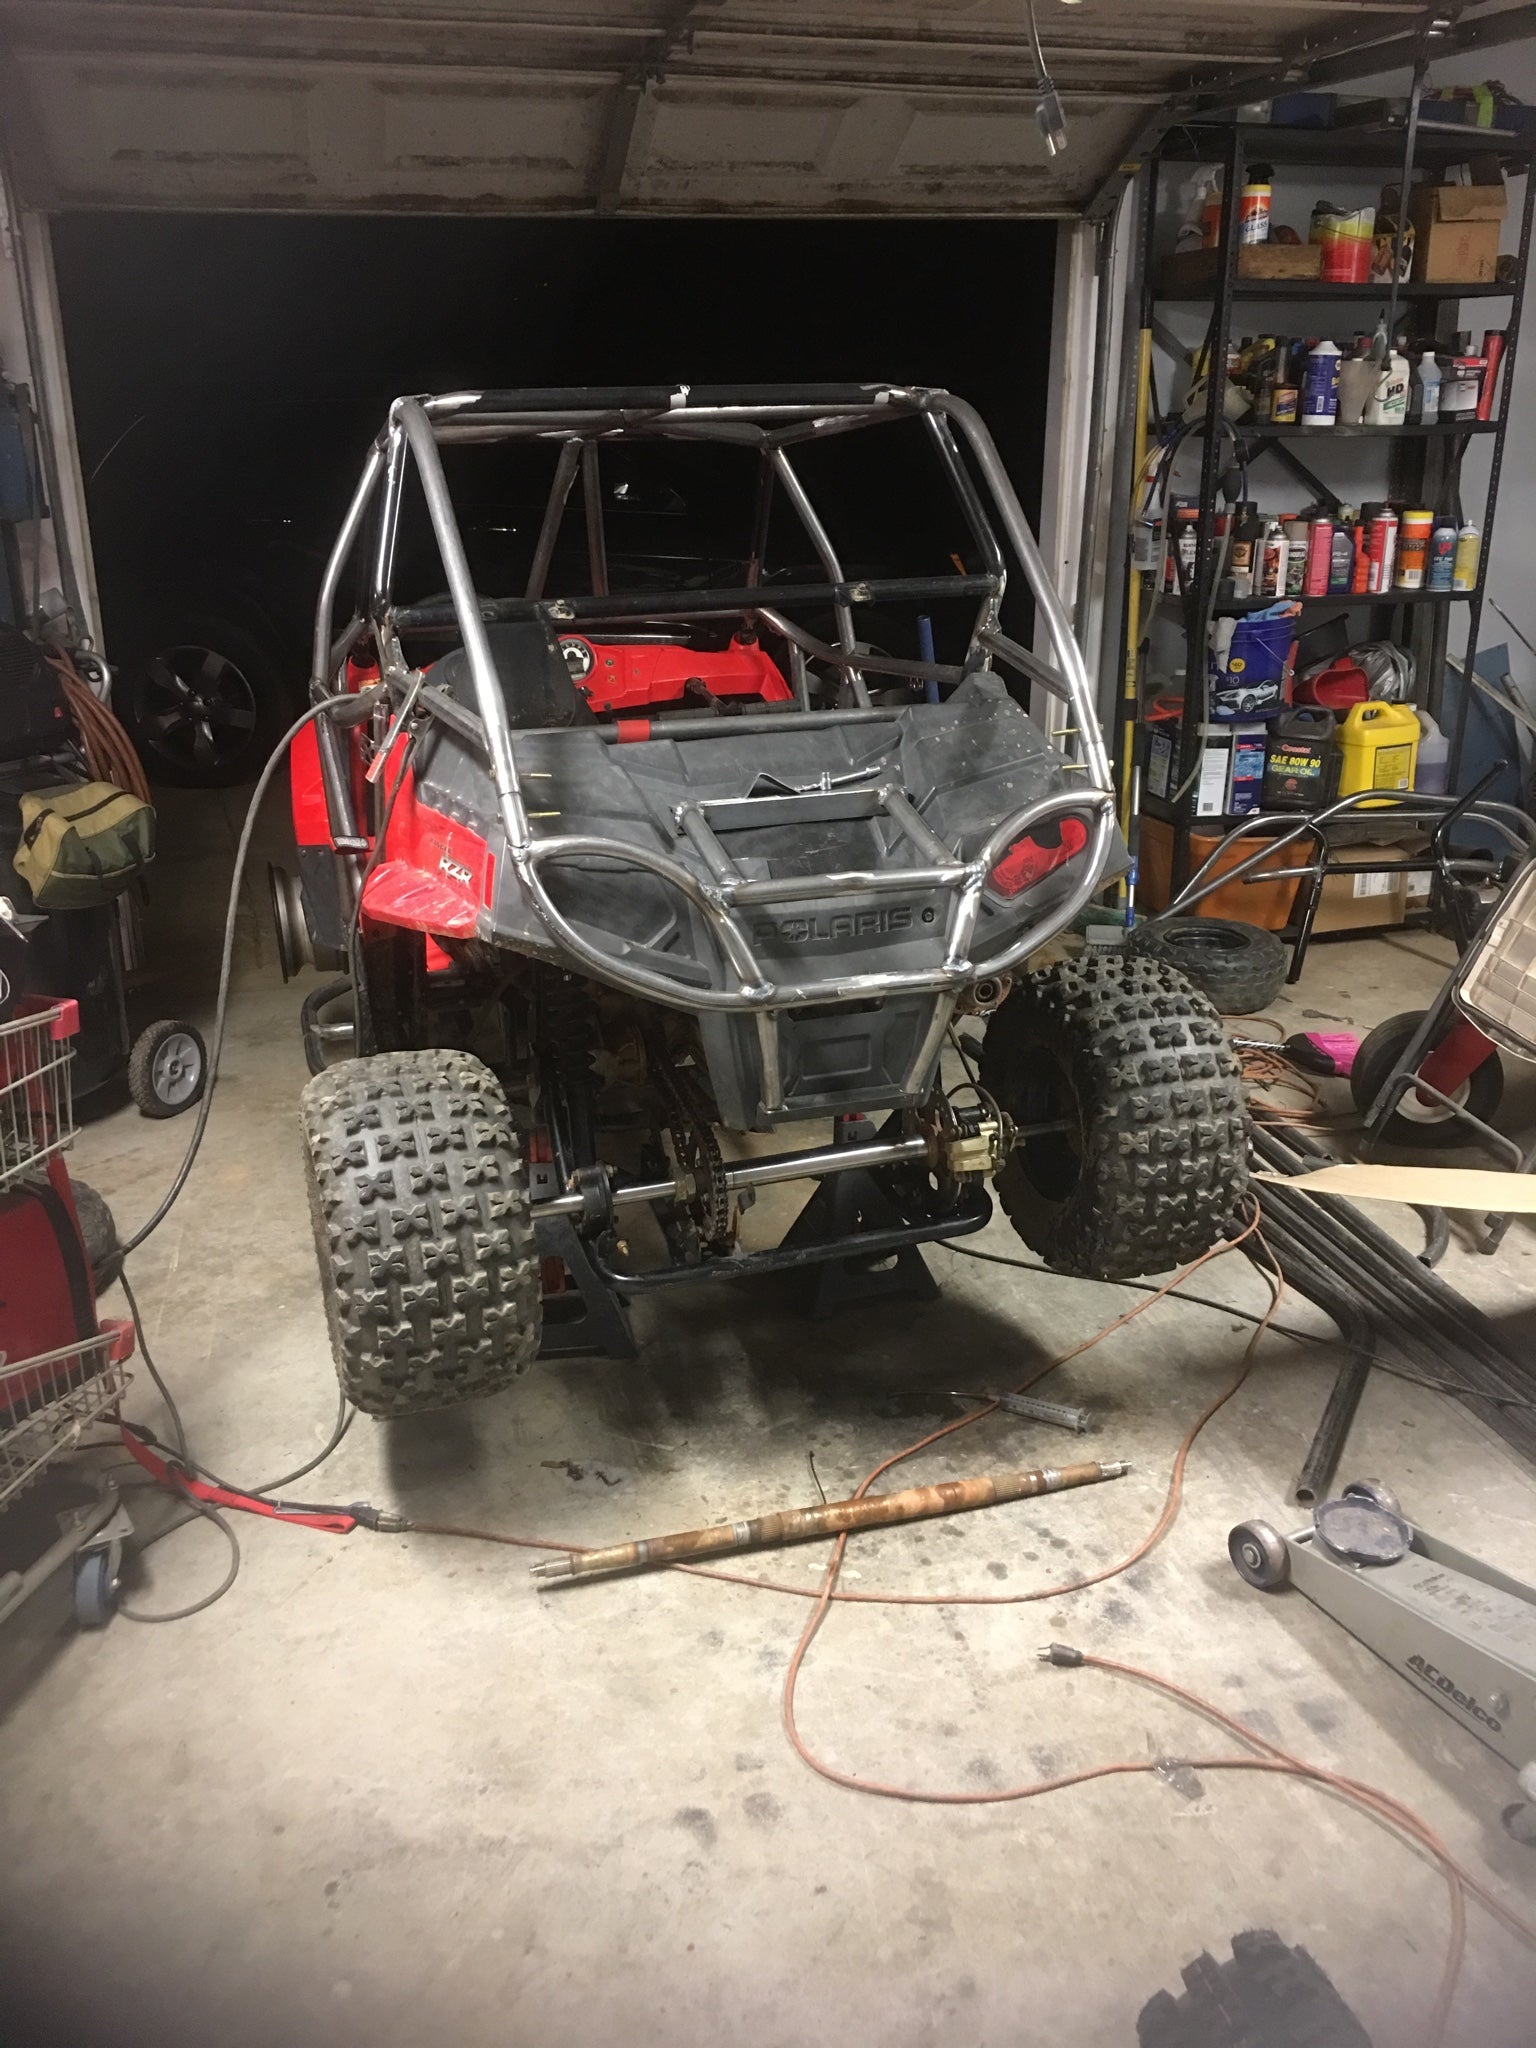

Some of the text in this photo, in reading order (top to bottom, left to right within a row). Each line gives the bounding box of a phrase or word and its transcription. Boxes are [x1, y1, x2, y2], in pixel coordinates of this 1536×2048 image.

[1386, 383, 1404, 397] HD
[1270, 754, 1289, 765] SAE
[1289, 757, 1309, 767] 80W
[1309, 758, 1321, 768] 90
[1271, 764, 1299, 774] GEAR
[1299, 767, 1315, 777] OIL
[752, 906, 913, 948] POLARIS
[1406, 1654, 1502, 1732] ACDelco
